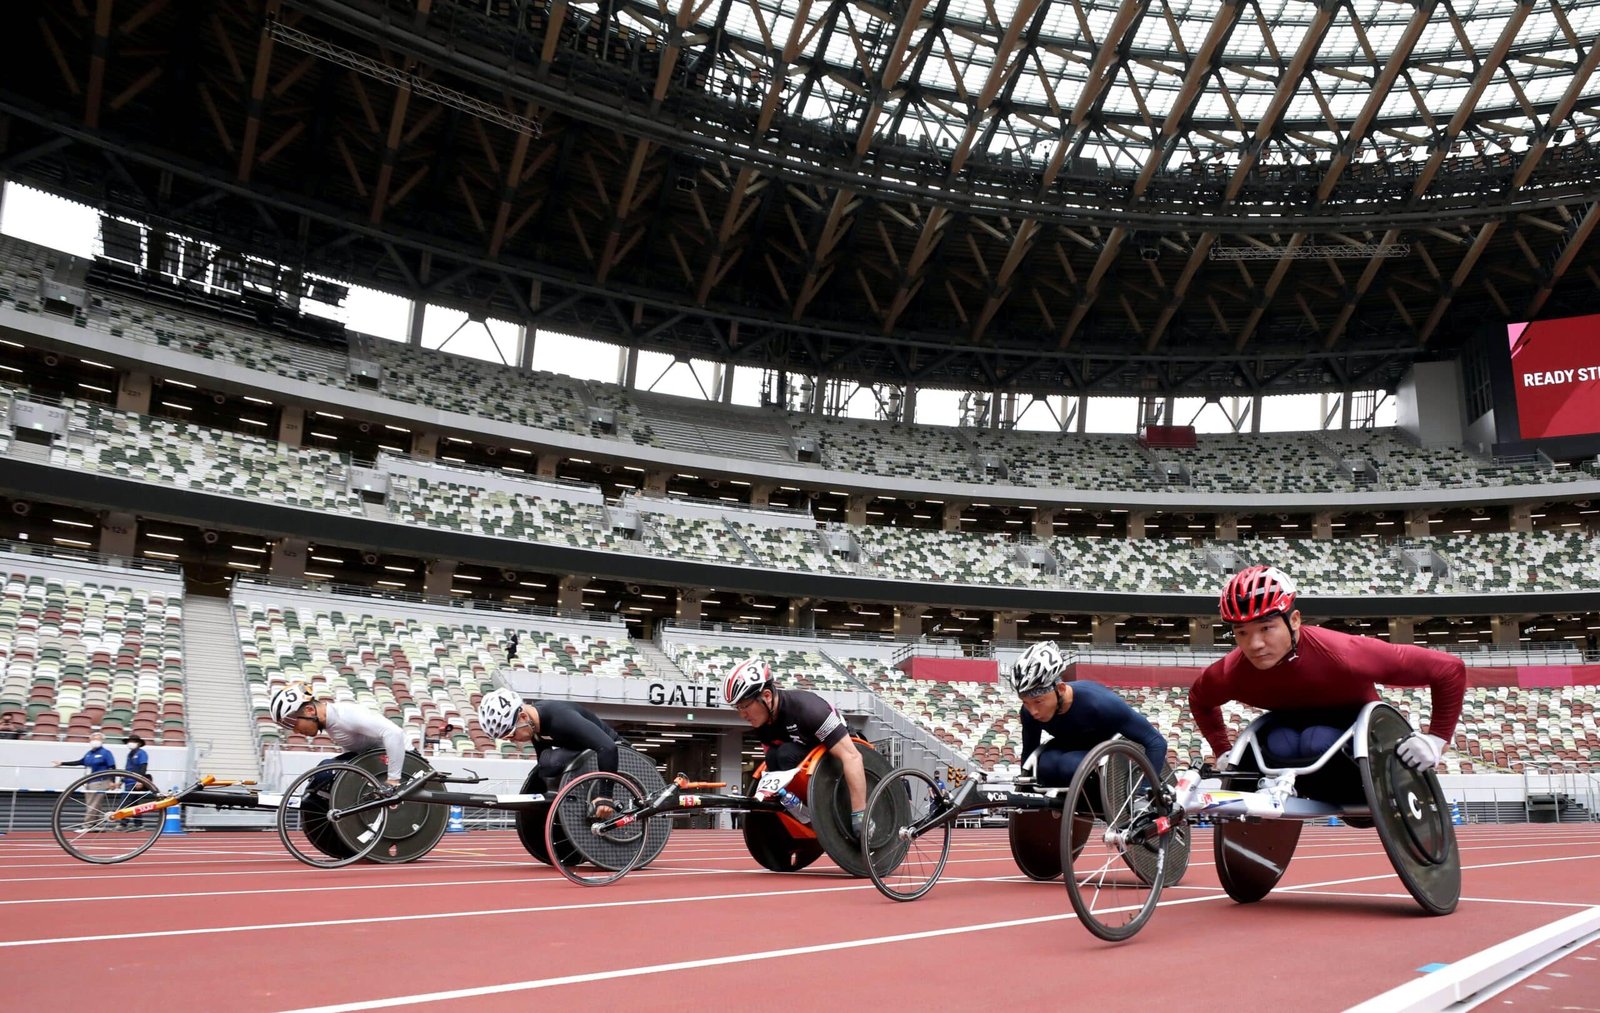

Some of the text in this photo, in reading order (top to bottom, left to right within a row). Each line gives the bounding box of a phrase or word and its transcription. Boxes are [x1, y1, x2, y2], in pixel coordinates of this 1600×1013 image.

[1523, 368, 1574, 387] READY
[1038, 645, 1058, 667] 2
[748, 665, 761, 682] 3
[285, 689, 297, 703] 5
[498, 696, 511, 709] 4
[648, 683, 720, 708] GATE
[760, 778, 780, 791] 23
